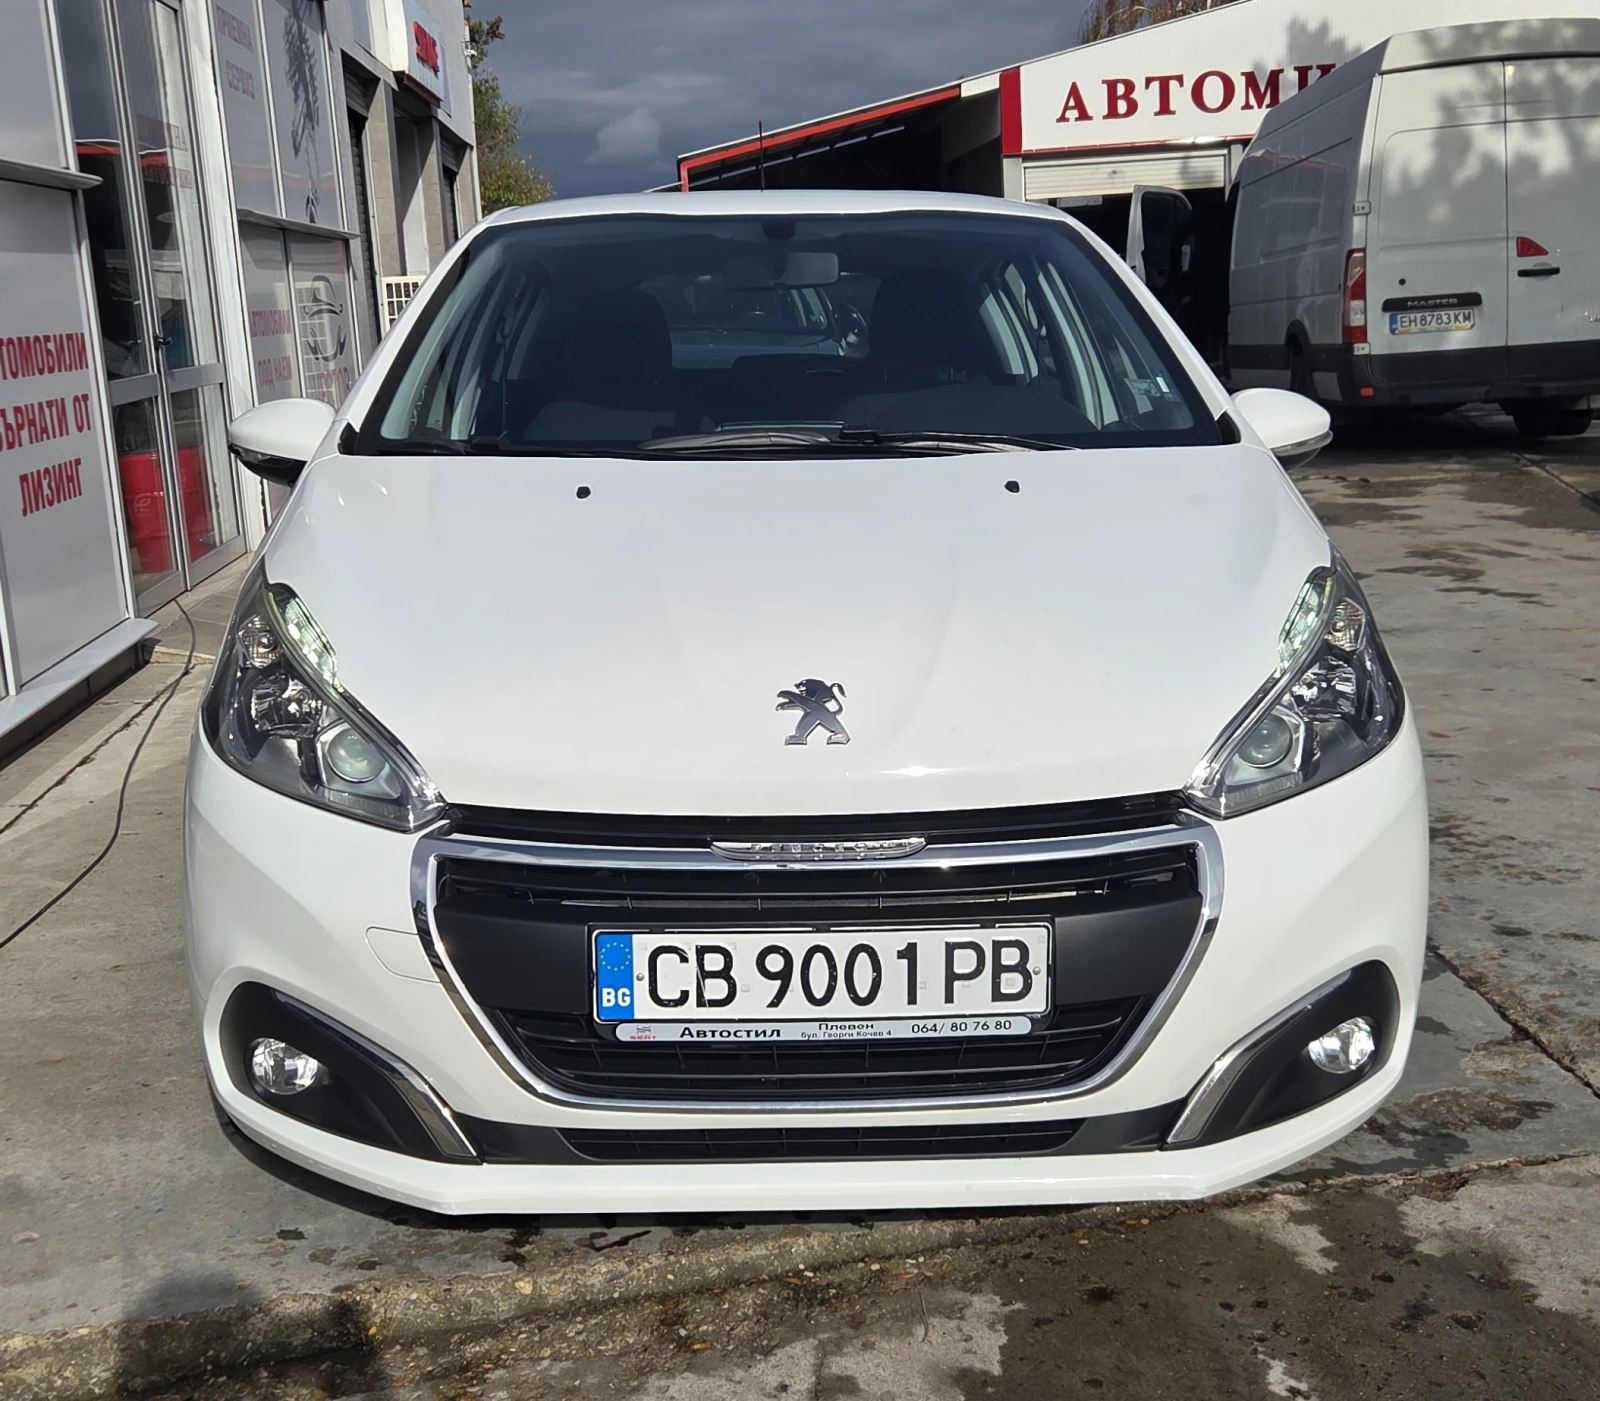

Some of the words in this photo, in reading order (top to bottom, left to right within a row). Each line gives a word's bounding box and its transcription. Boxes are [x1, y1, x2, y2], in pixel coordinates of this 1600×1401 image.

[1407, 298, 1458, 307] MASTER
[1400, 314, 1418, 328] EH
[1420, 312, 1452, 326] 8783
[1453, 311, 1472, 324] KM
[0, 397, 70, 452] ЪРНАТИ
[72, 393, 91, 434] ОТ
[19, 457, 83, 517] ЛИЗИНГ
[648, 944, 737, 1008] CB
[756, 941, 918, 1008] 9001
[944, 939, 1033, 1004] PB
[602, 987, 631, 1008] BG
[680, 1026, 781, 1039] Автостил
[911, 1022, 945, 1034] 064/
[950, 1021, 968, 1032] 80
[972, 1020, 990, 1031] 76
[994, 1019, 1012, 1030] 80
[800, 1031, 821, 1040] бул.
[823, 1030, 854, 1039] Георги
[885, 1029, 892, 1037] 4
